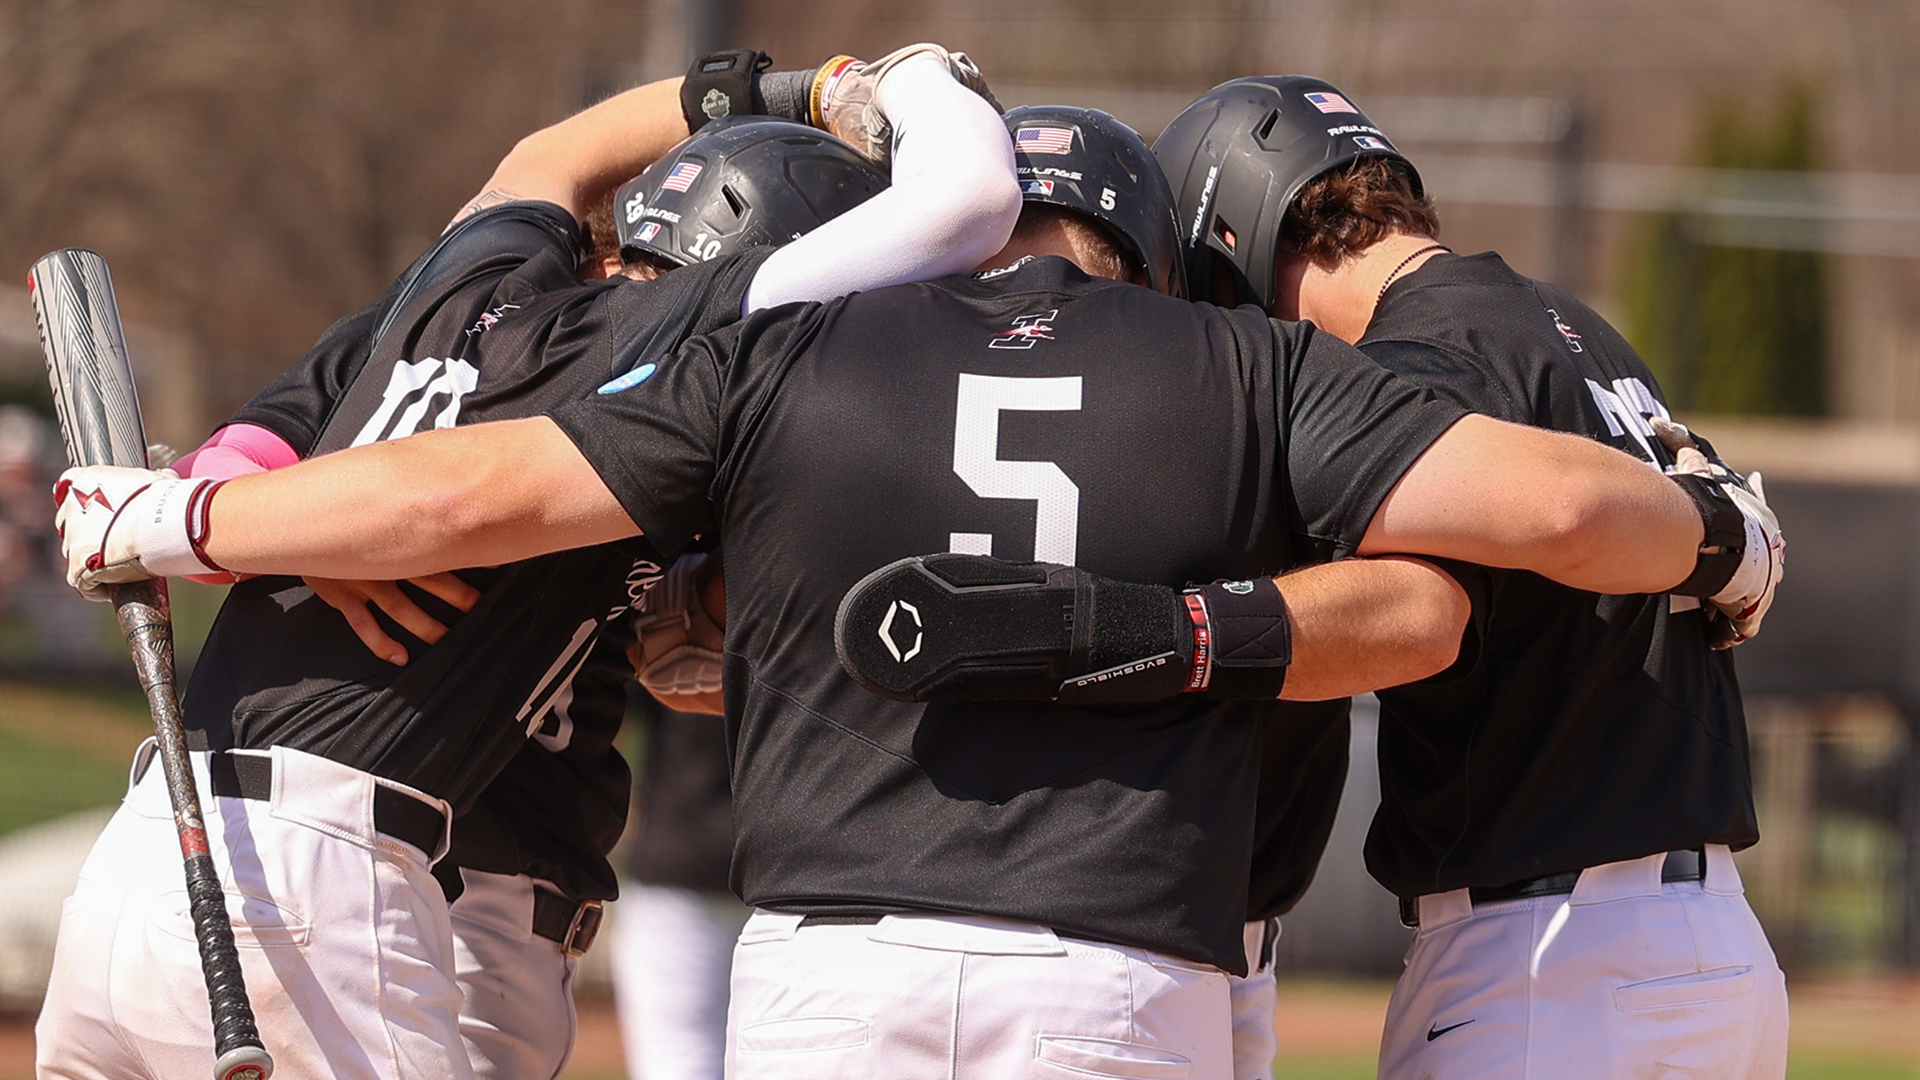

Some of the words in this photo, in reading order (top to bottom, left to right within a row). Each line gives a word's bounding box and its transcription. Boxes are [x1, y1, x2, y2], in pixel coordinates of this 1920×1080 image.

[1100, 188, 1117, 211] 5
[688, 232, 722, 262] 10
[950, 372, 1083, 568] 5
[1196, 631, 1207, 664] Harris
[1077, 657, 1167, 687] EVOSHIELD
[1191, 665, 1205, 688] Brett
